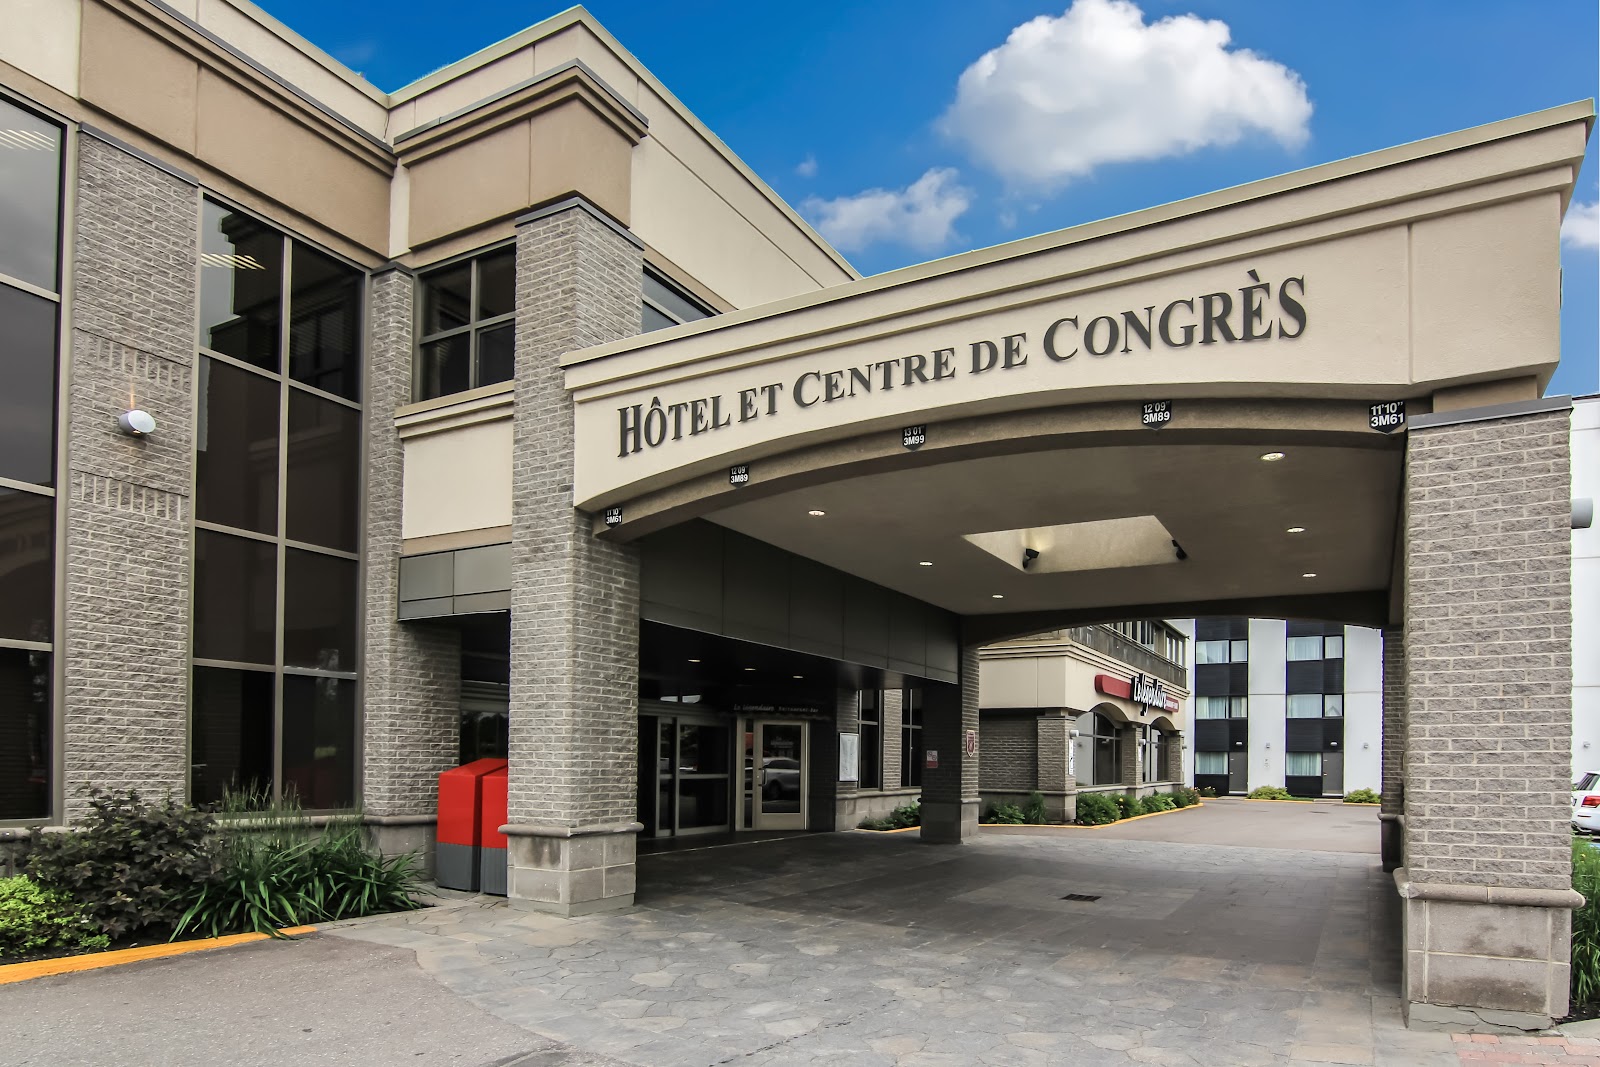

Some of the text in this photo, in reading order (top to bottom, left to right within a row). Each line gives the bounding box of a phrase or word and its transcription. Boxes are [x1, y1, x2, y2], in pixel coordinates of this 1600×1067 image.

[617, 268, 1307, 458] HÔTEL ET CENTRE DE CONGRÈS
[1143, 411, 1170, 424] 3M89
[1370, 413, 1403, 427] 3M61
[903, 435, 925, 446] 3M99
[730, 473, 749, 484] 3M89
[606, 514, 622, 525] 3M61
